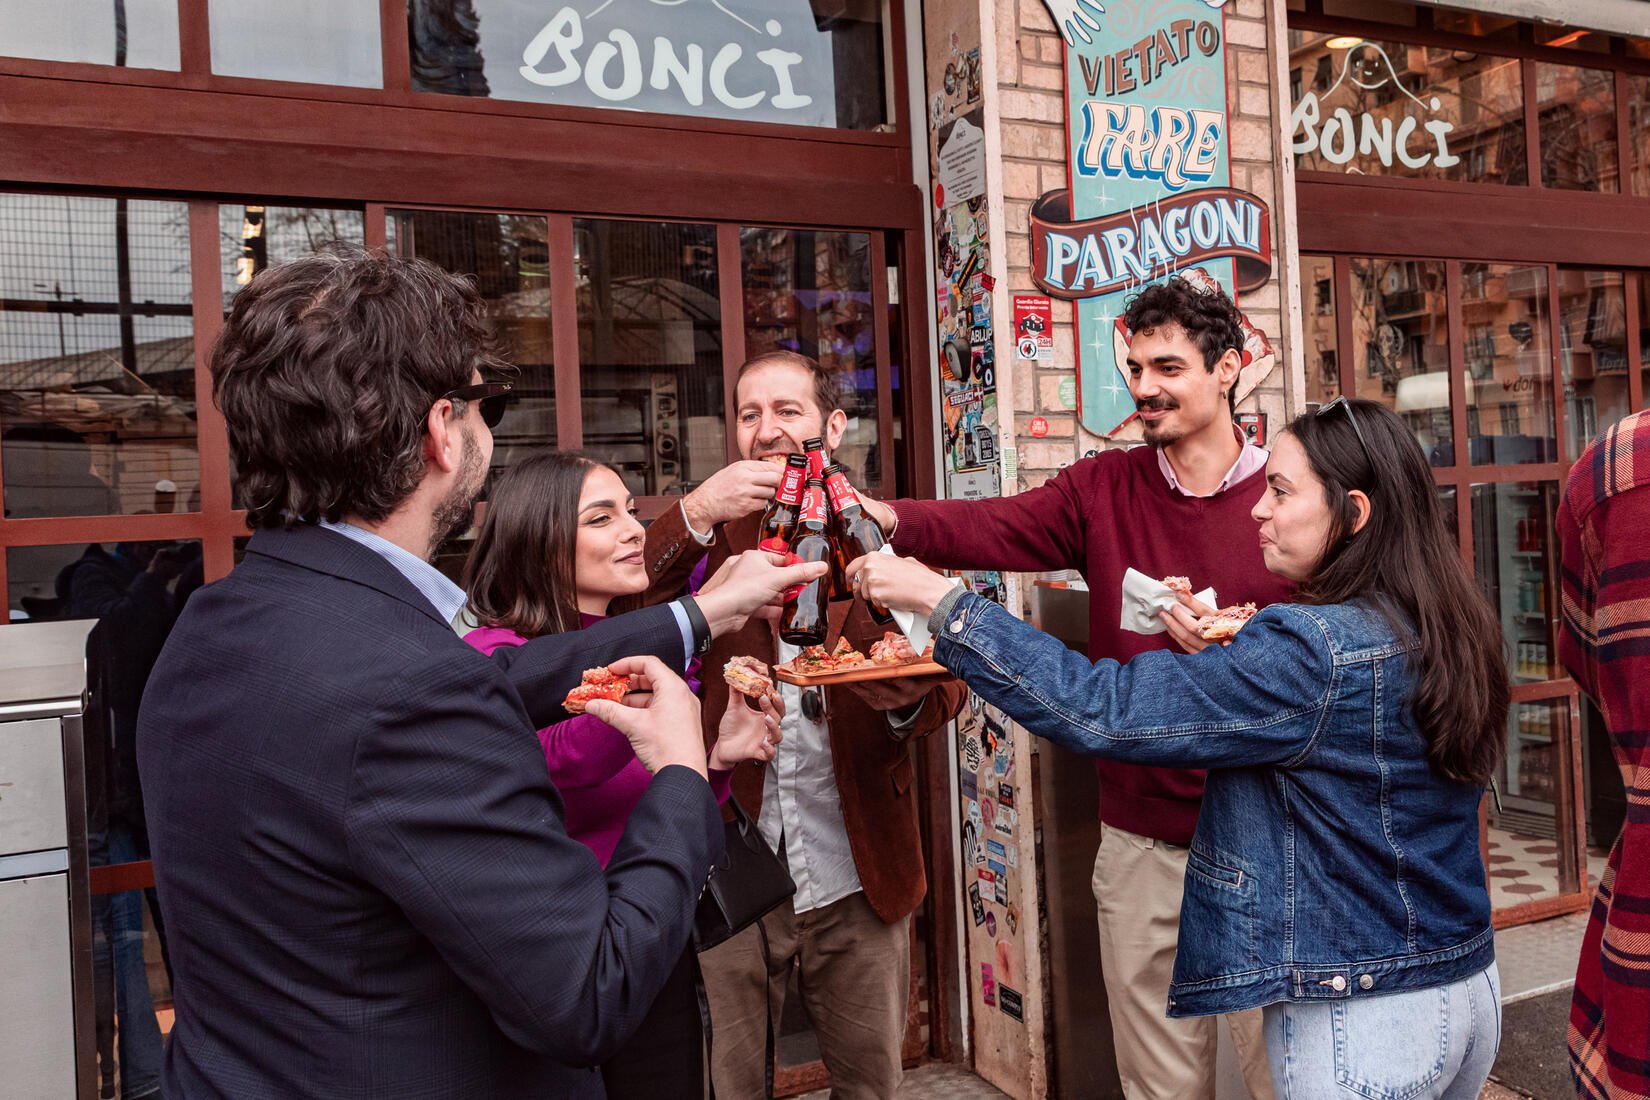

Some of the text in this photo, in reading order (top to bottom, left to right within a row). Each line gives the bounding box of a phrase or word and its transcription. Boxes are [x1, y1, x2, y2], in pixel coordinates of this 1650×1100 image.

[1077, 19, 1220, 97] VIETATO
[1075, 99, 1225, 191] FARE
[1045, 197, 1263, 291] PARAGONI
